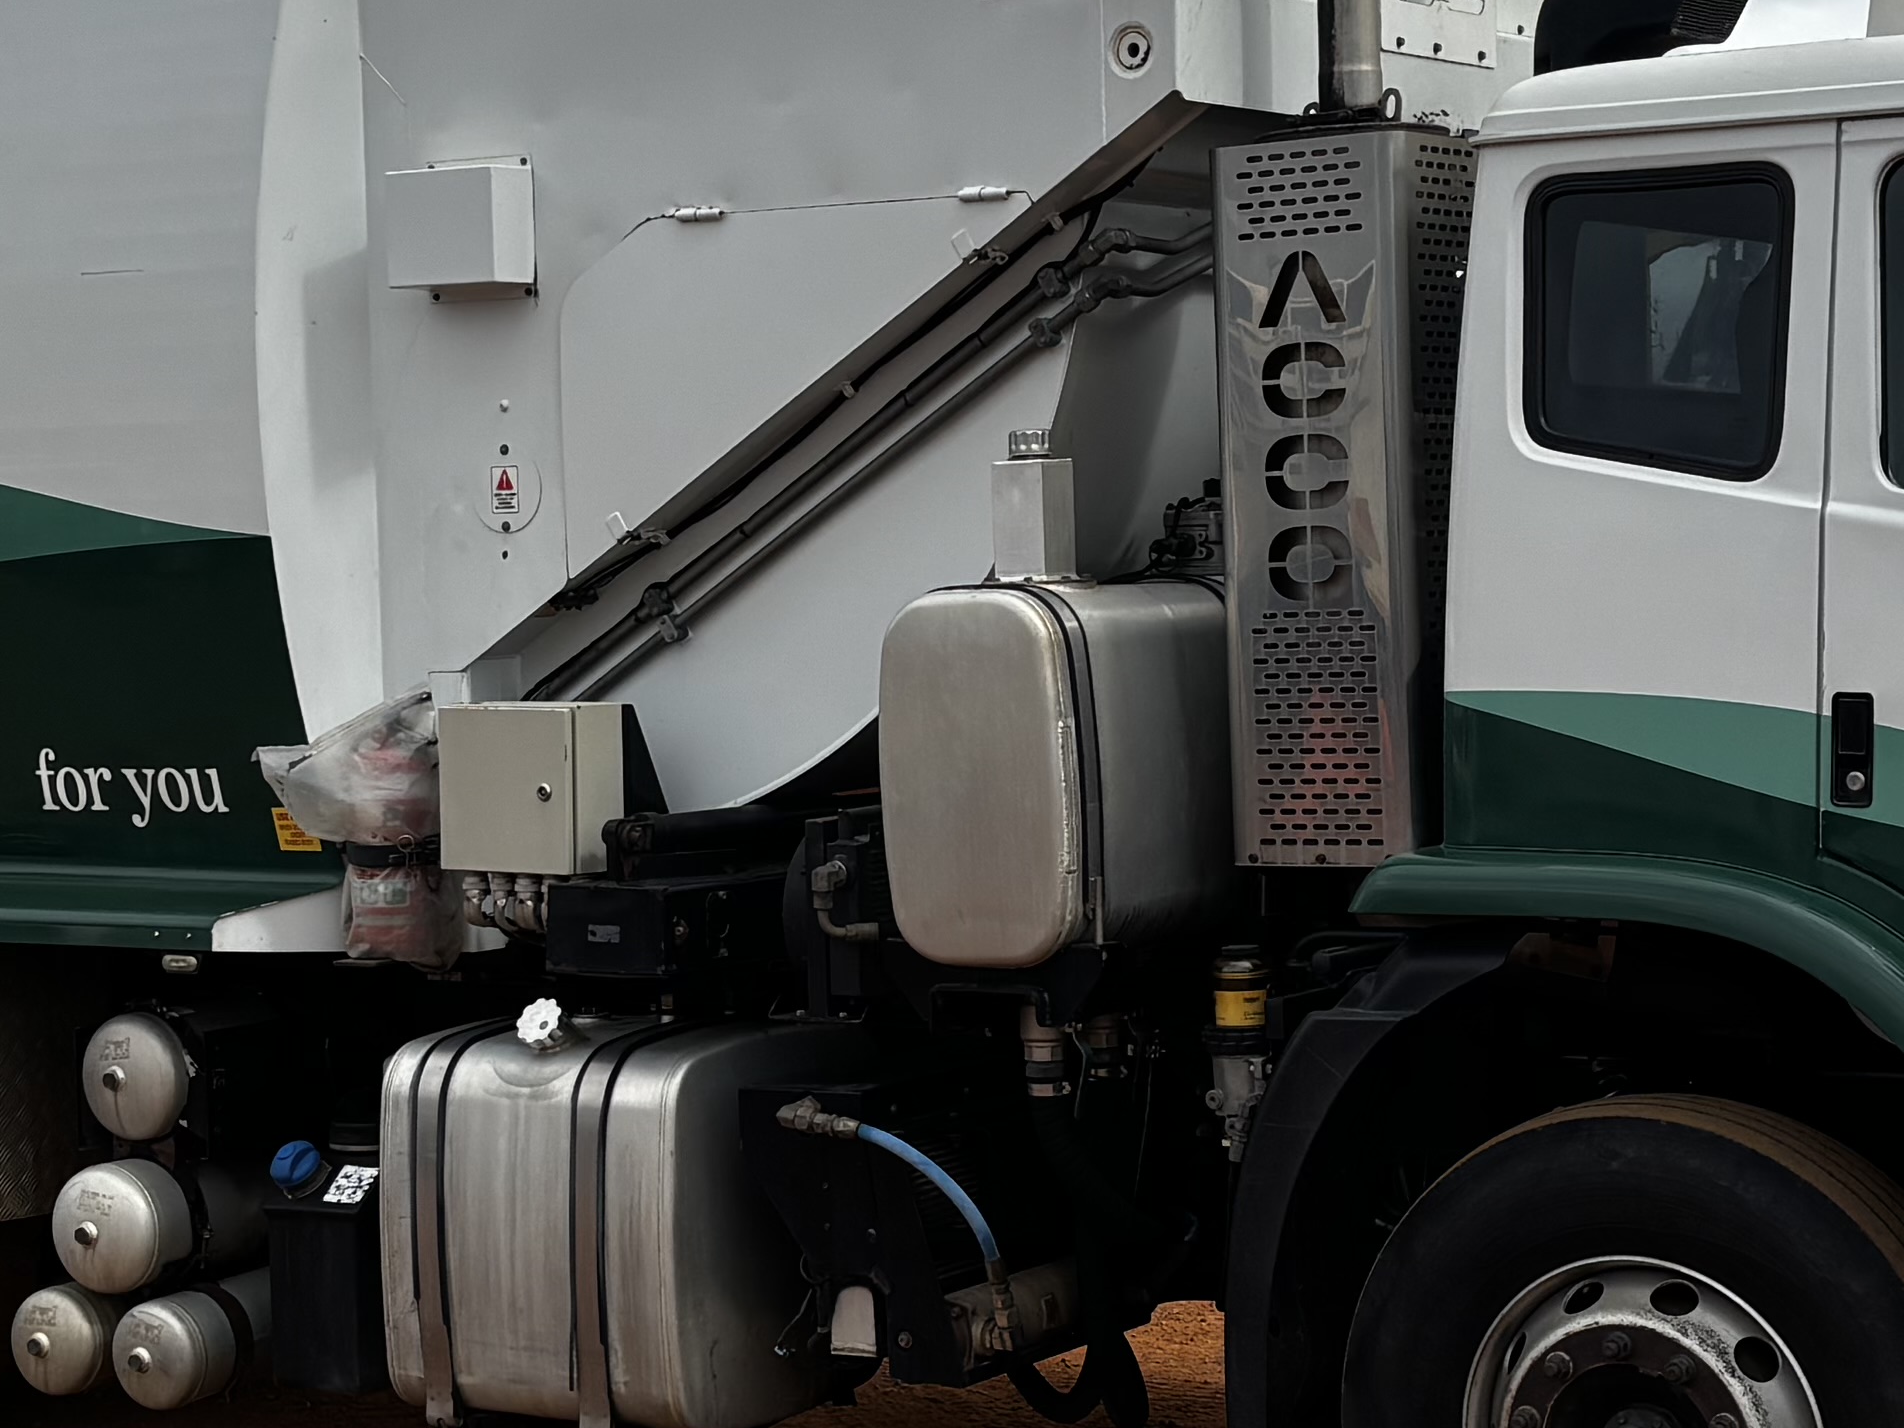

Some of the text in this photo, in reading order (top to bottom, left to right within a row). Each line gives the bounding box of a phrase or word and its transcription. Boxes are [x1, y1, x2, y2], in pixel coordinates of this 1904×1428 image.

[1258, 250, 1354, 602] ACCO
[35, 747, 230, 828] for you
